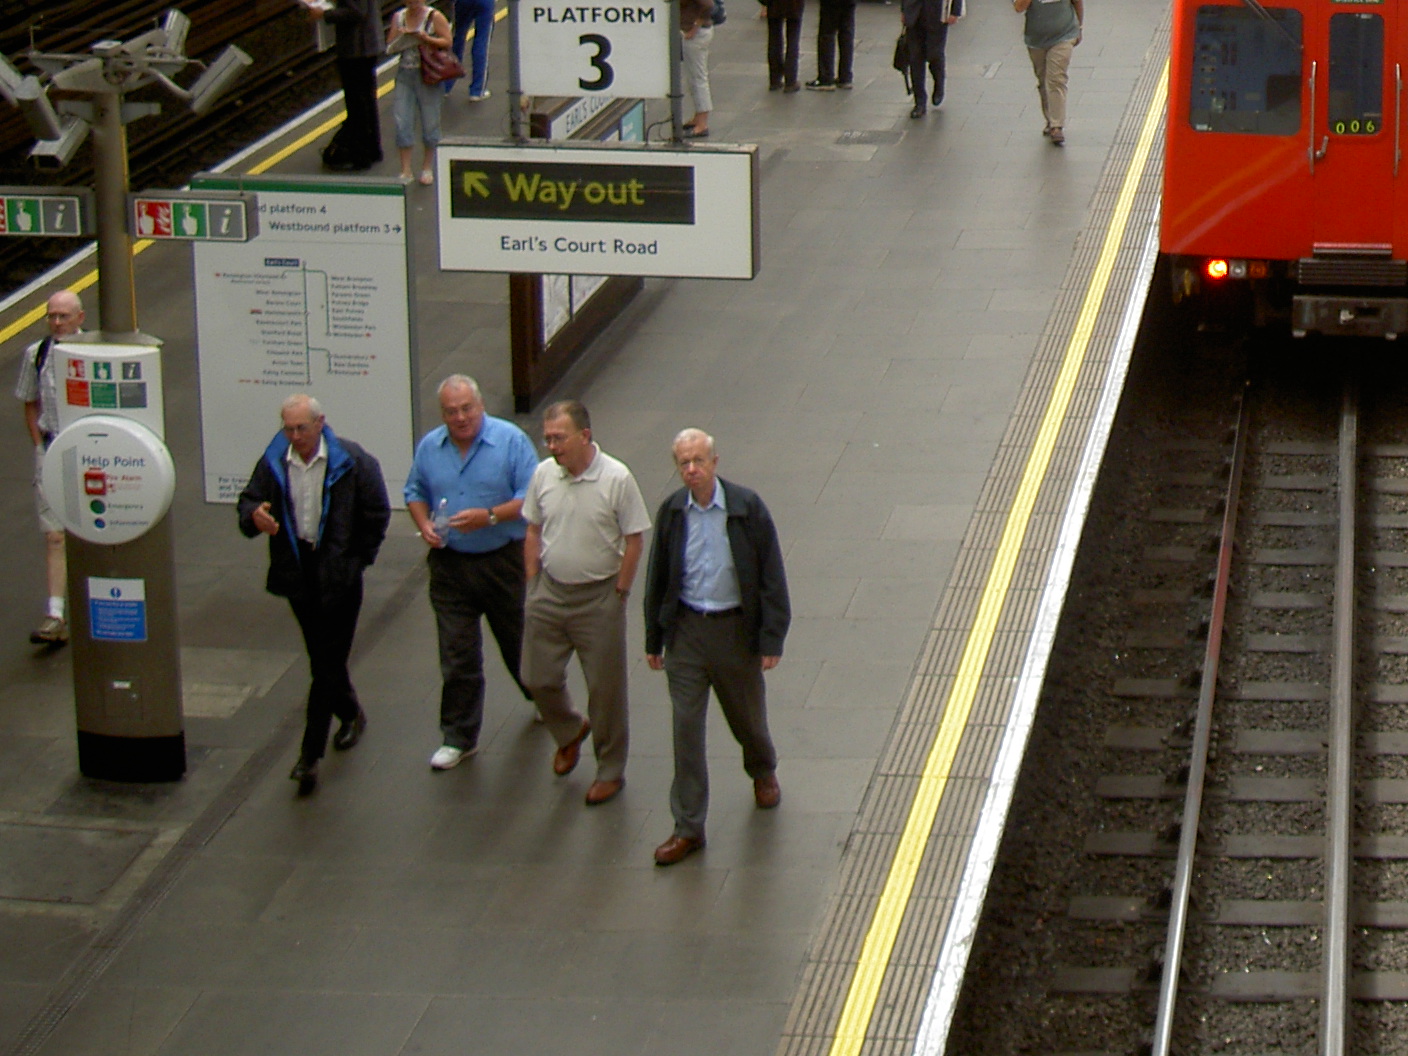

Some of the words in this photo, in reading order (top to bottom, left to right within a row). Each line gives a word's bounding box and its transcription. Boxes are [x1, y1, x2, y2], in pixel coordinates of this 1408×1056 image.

[533, 7, 655, 23] PLATFORM
[578, 33, 615, 91] 3
[502, 172, 577, 210] Way
[583, 178, 645, 206] out
[270, 204, 317, 215] platform
[319, 205, 327, 214] 4
[269, 221, 330, 233] Westbound
[332, 223, 380, 234] platform
[384, 224, 390, 233] 3
[501, 235, 548, 252] Earl's
[554, 237, 607, 253] Court
[614, 239, 658, 255] Road
[82, 455, 110, 468] Help
[114, 455, 146, 468] Point
